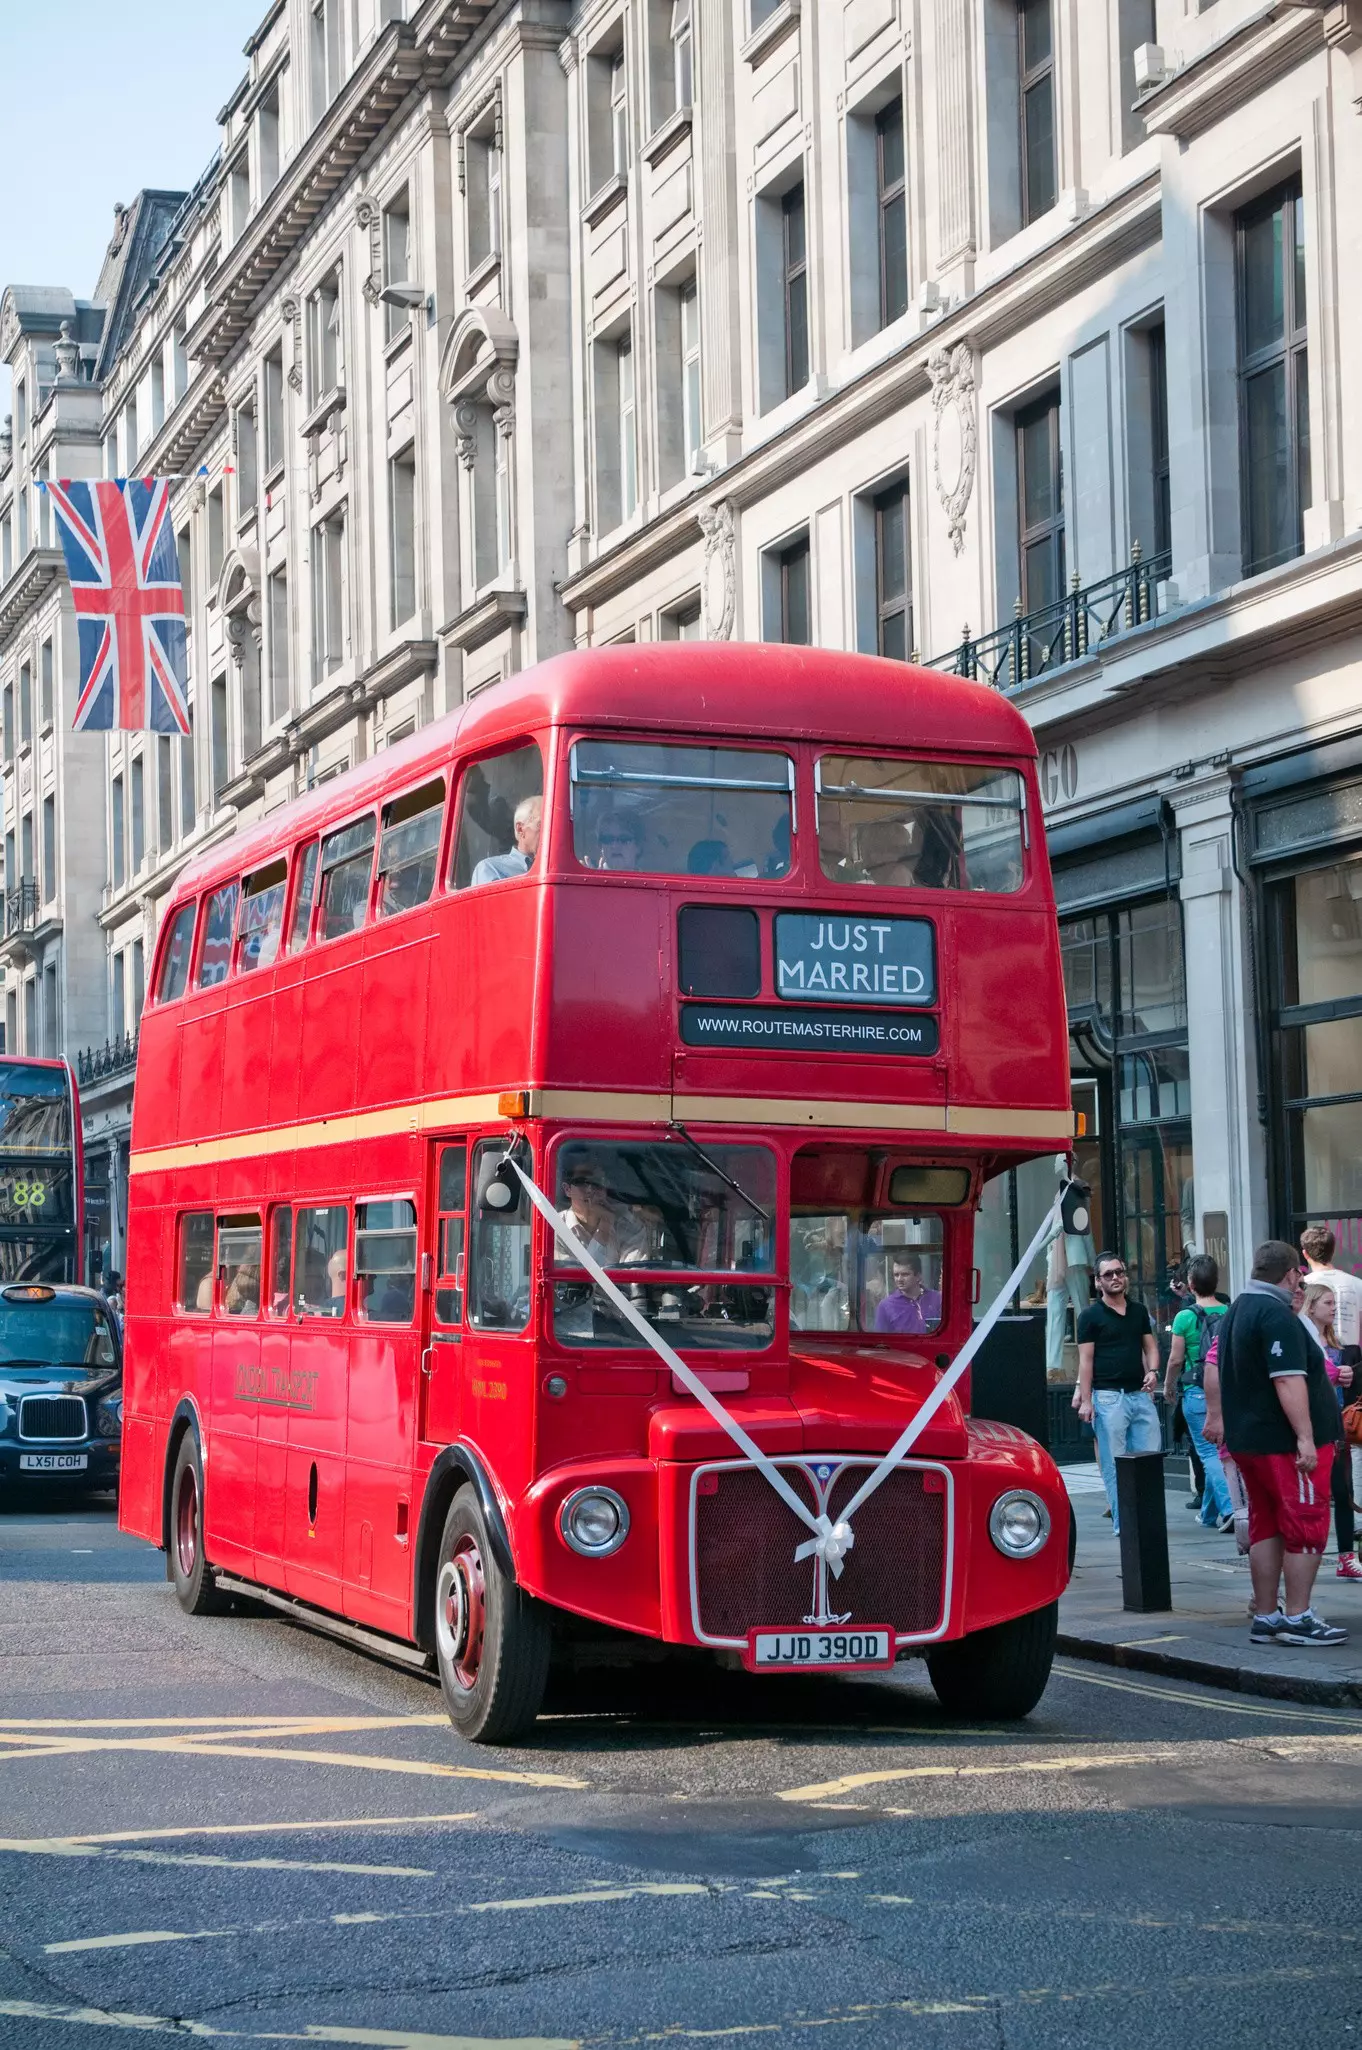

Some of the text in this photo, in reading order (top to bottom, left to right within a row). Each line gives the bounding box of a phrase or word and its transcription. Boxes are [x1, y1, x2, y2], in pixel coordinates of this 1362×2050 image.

[810, 922, 892, 954] JUST
[778, 959, 925, 994] MARRIED
[697, 1017, 922, 1042] WWW.ROUTEMASTERHIRE.COM
[13, 1181, 46, 1206] 88
[1270, 1340, 1283, 1357] 4
[27, 1455, 81, 1467] LX51 COH
[767, 1635, 878, 1660] JJD 390D
